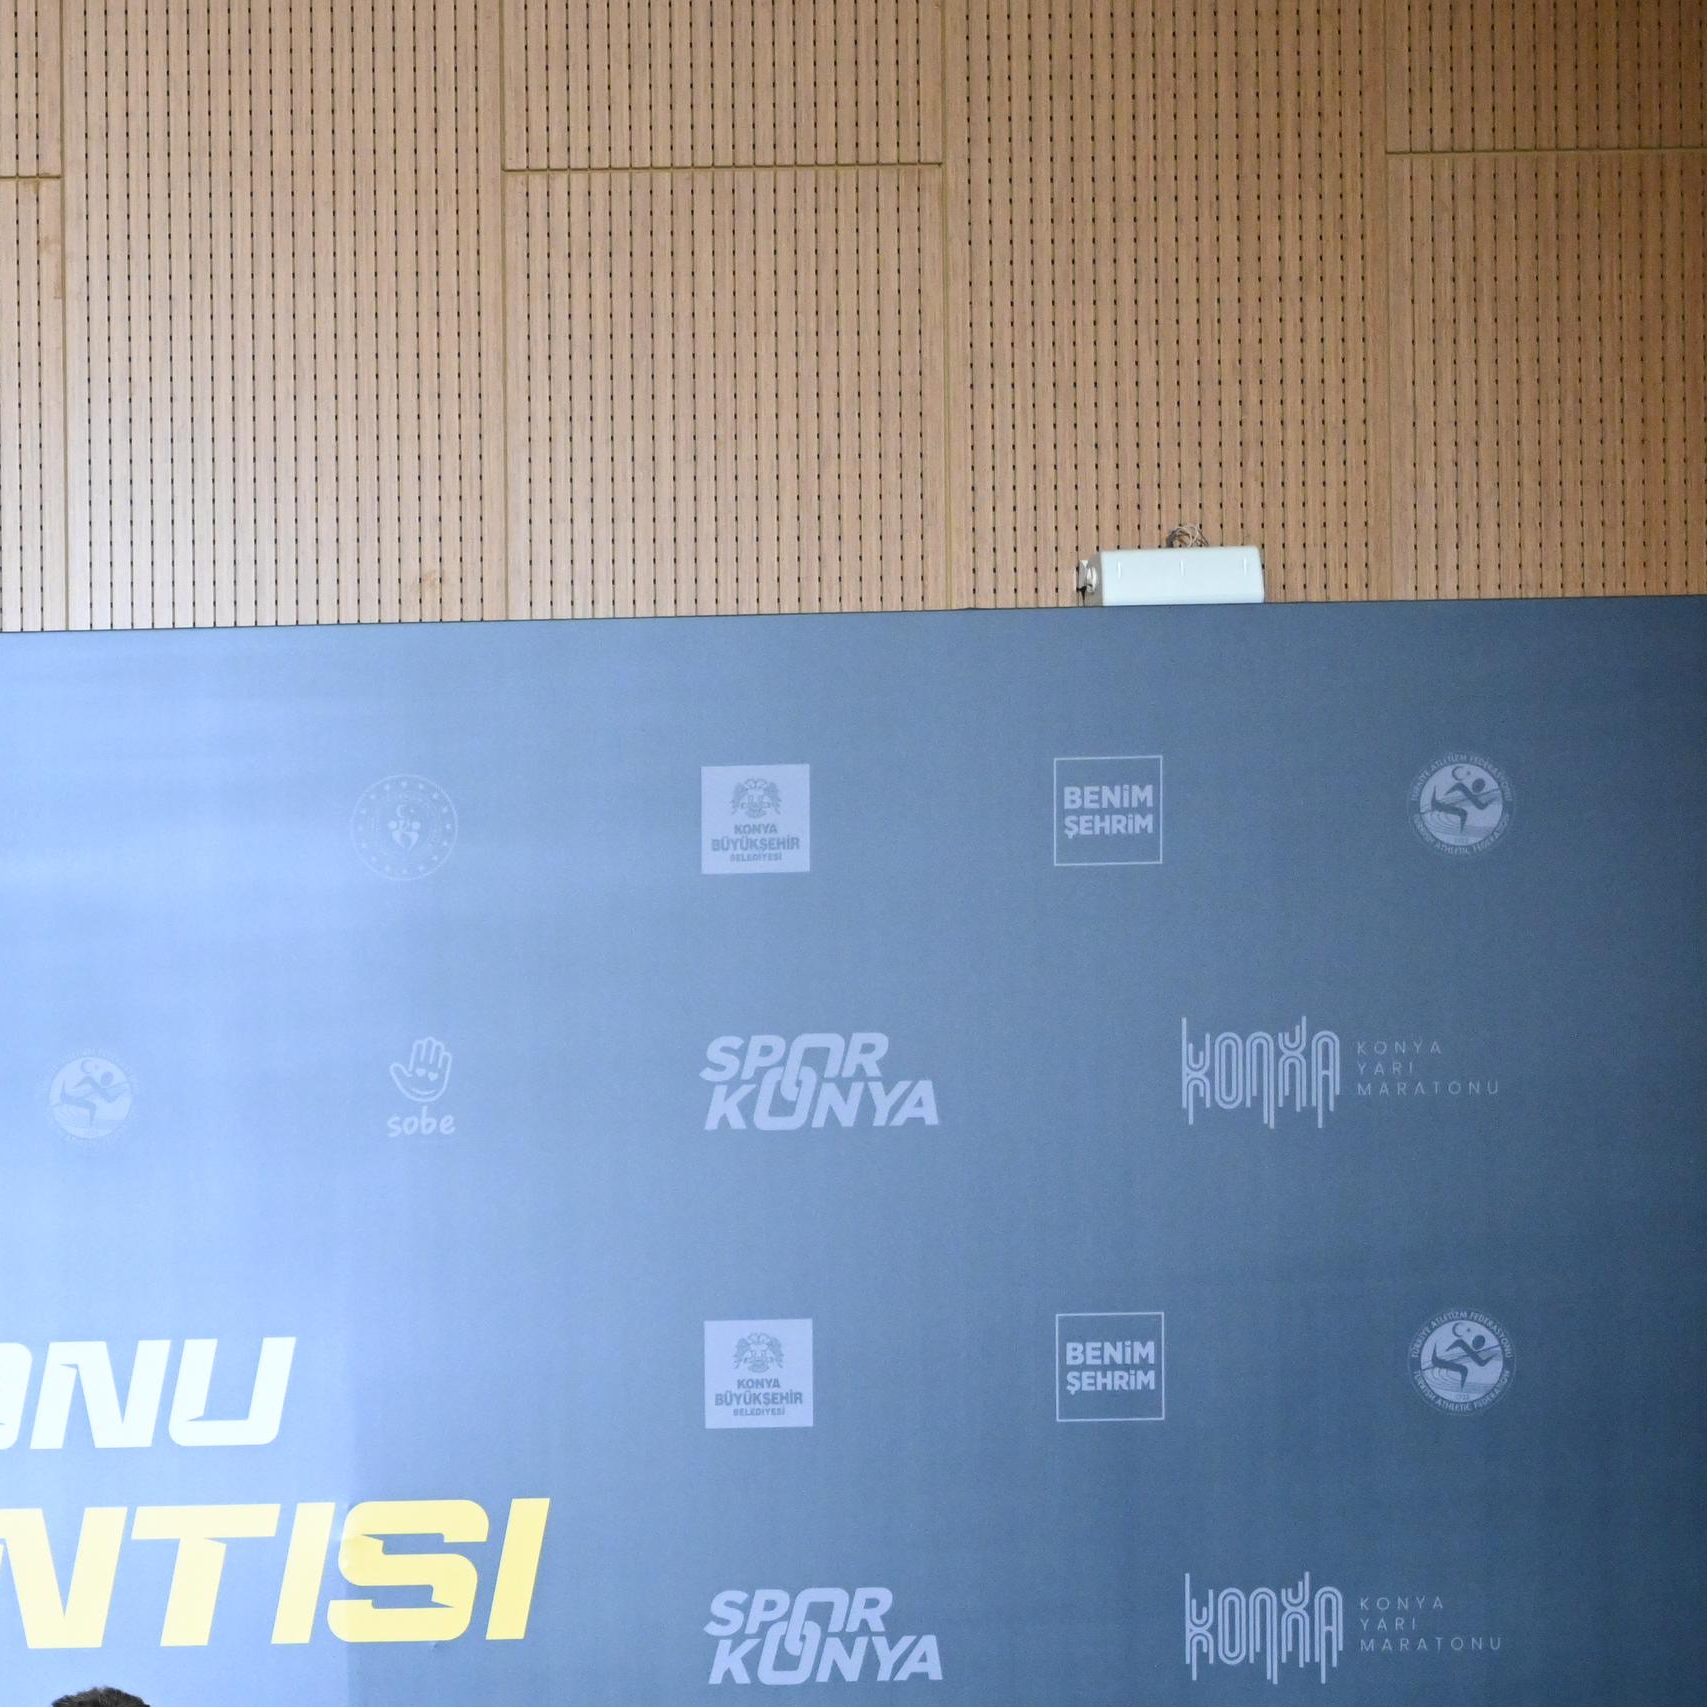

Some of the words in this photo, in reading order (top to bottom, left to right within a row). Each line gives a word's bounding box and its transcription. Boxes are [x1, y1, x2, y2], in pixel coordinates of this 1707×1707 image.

[734, 823, 779, 835] KONYA
[1356, 1041, 1440, 1055] KONYA
[700, 1033, 888, 1082] SPOR
[1356, 1061, 1413, 1076] YARI
[1356, 1082, 1499, 1096] MARATONU
[705, 1074, 940, 1129] KONYA
[387, 1105, 456, 1138] sobe
[737, 1378, 782, 1389] KONYA
[1359, 1597, 1443, 1611] KONYA
[704, 1588, 892, 1637] SPOR
[1359, 1617, 1416, 1632] YARI
[1359, 1638, 1502, 1652] MARATONU
[709, 1629, 944, 1684] KONYA
